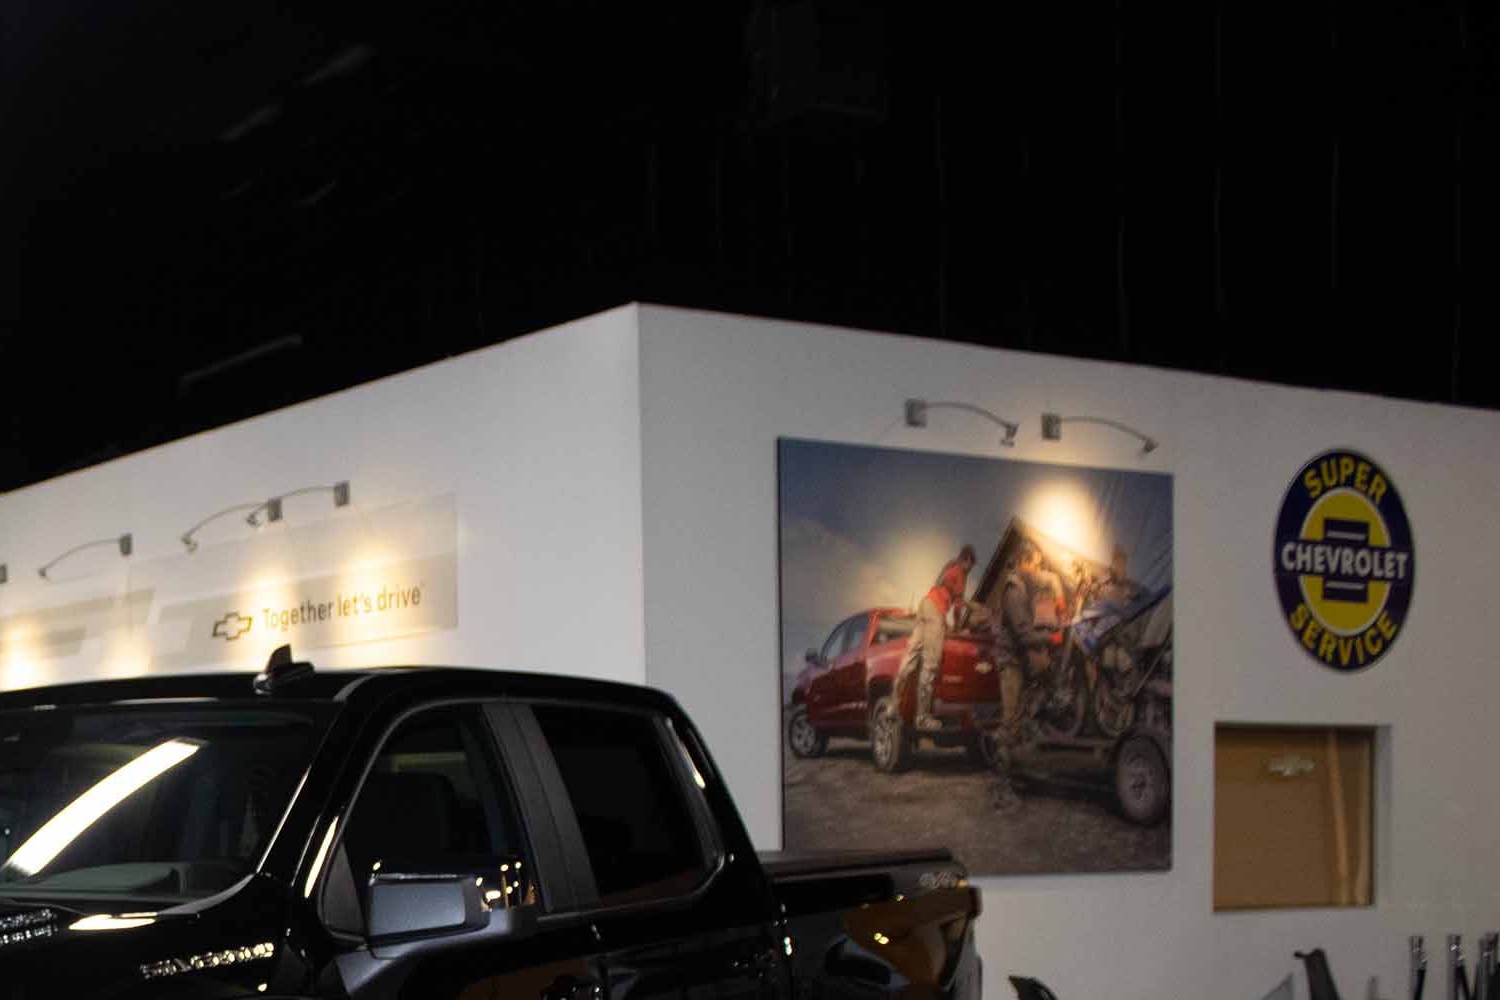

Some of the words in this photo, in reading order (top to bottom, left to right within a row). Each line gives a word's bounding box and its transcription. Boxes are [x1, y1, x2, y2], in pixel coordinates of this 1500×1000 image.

[1304, 457, 1387, 503] SUPER
[1281, 542, 1409, 579] CHEVROLET
[262, 599, 334, 631] Together
[336, 592, 372, 617] let's
[377, 583, 421, 612] drive
[1291, 603, 1398, 666] SERVICE
